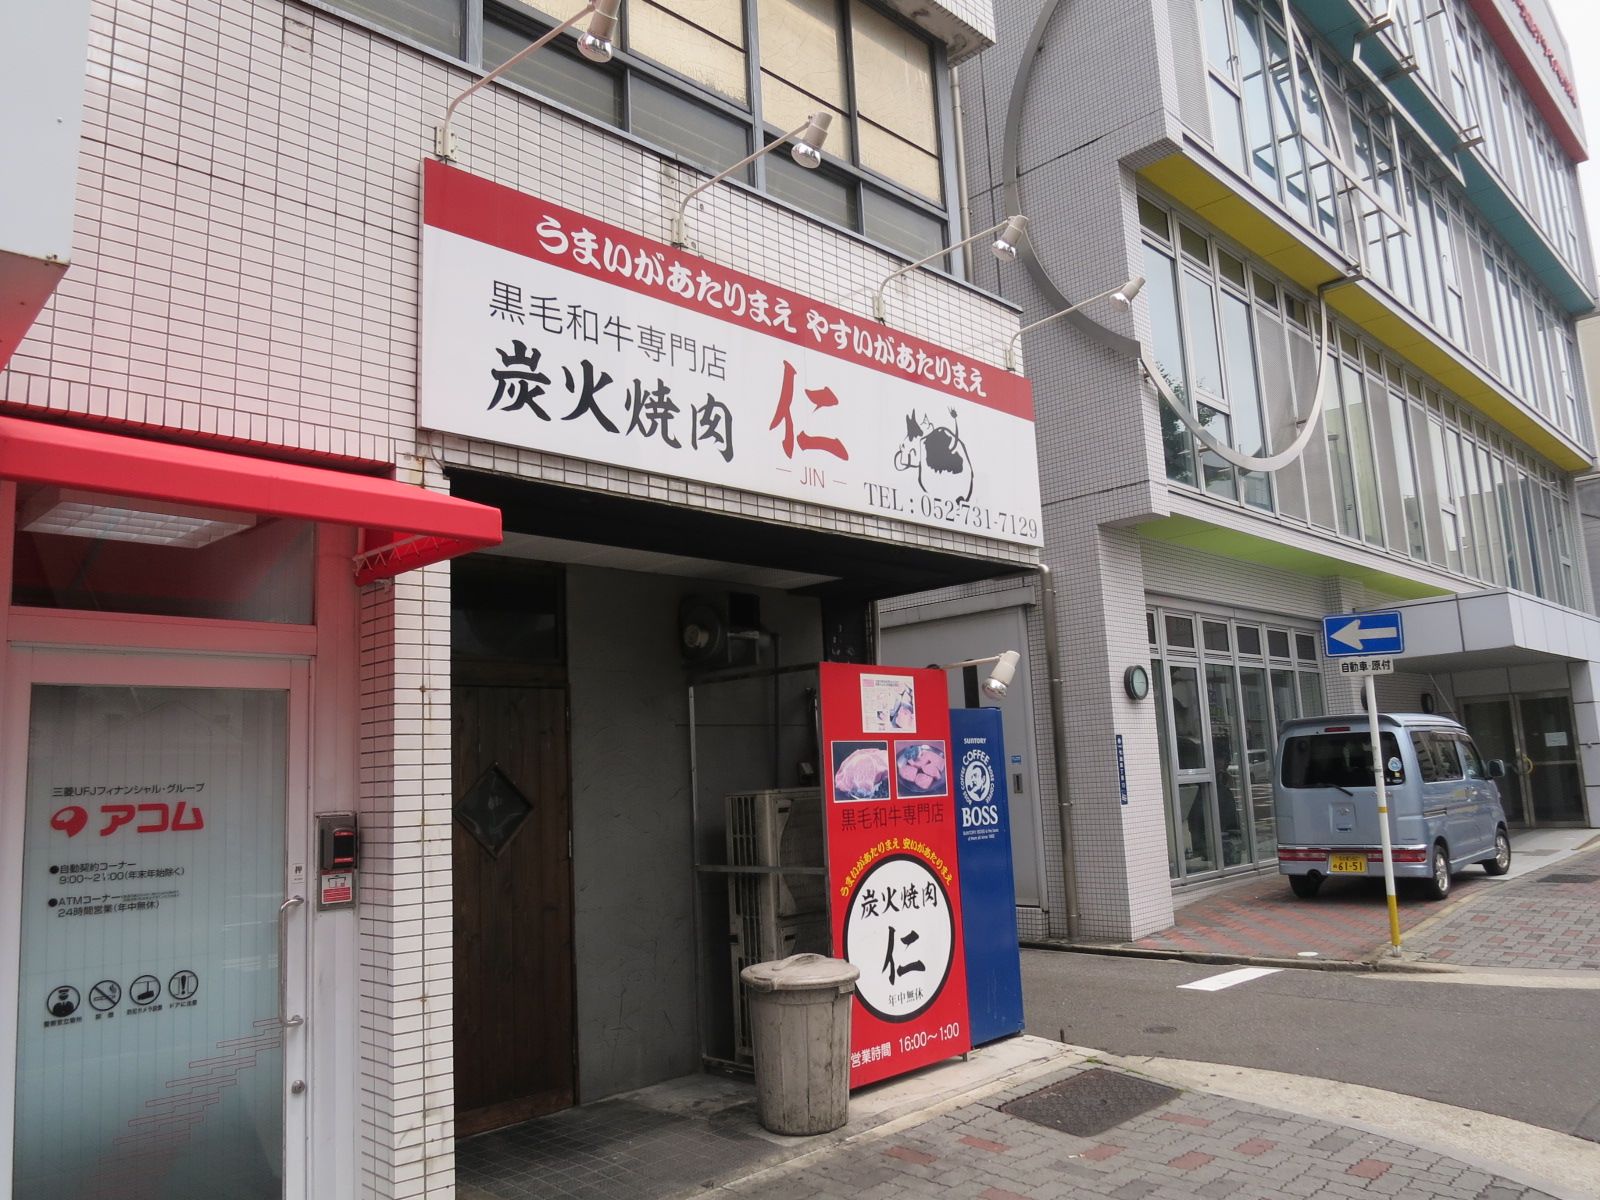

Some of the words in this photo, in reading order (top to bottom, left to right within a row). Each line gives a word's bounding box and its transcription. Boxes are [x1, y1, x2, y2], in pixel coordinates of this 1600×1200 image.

[536, 215, 797, 333] うまいがあたりまえ
[806, 309, 986, 397] やすいがあたりまえ
[489, 280, 727, 381] 黒毛和牛専門店
[487, 339, 734, 462] 炭火焼肉
[769, 360, 849, 461] 仁
[800, 467, 825, 488] JIN
[962, 749, 990, 766] COFFEE
[52, 783, 205, 798] 三菱UFJフィナンシャル・グループ
[100, 801, 204, 837] アコム
[841, 801, 944, 832] 黒毛和牛専門店
[961, 805, 998, 828] BOSS
[840, 838, 900, 897] うまいがあたりまえ
[902, 838, 953, 886] 安いがあたりまえ
[58, 894, 121, 906] ATMコーナー
[861, 881, 938, 920] 炭火焼肉
[882, 926, 926, 985] 仁
[888, 987, 924, 1007] 年中無休
[850, 1042, 892, 1068] 営業時間
